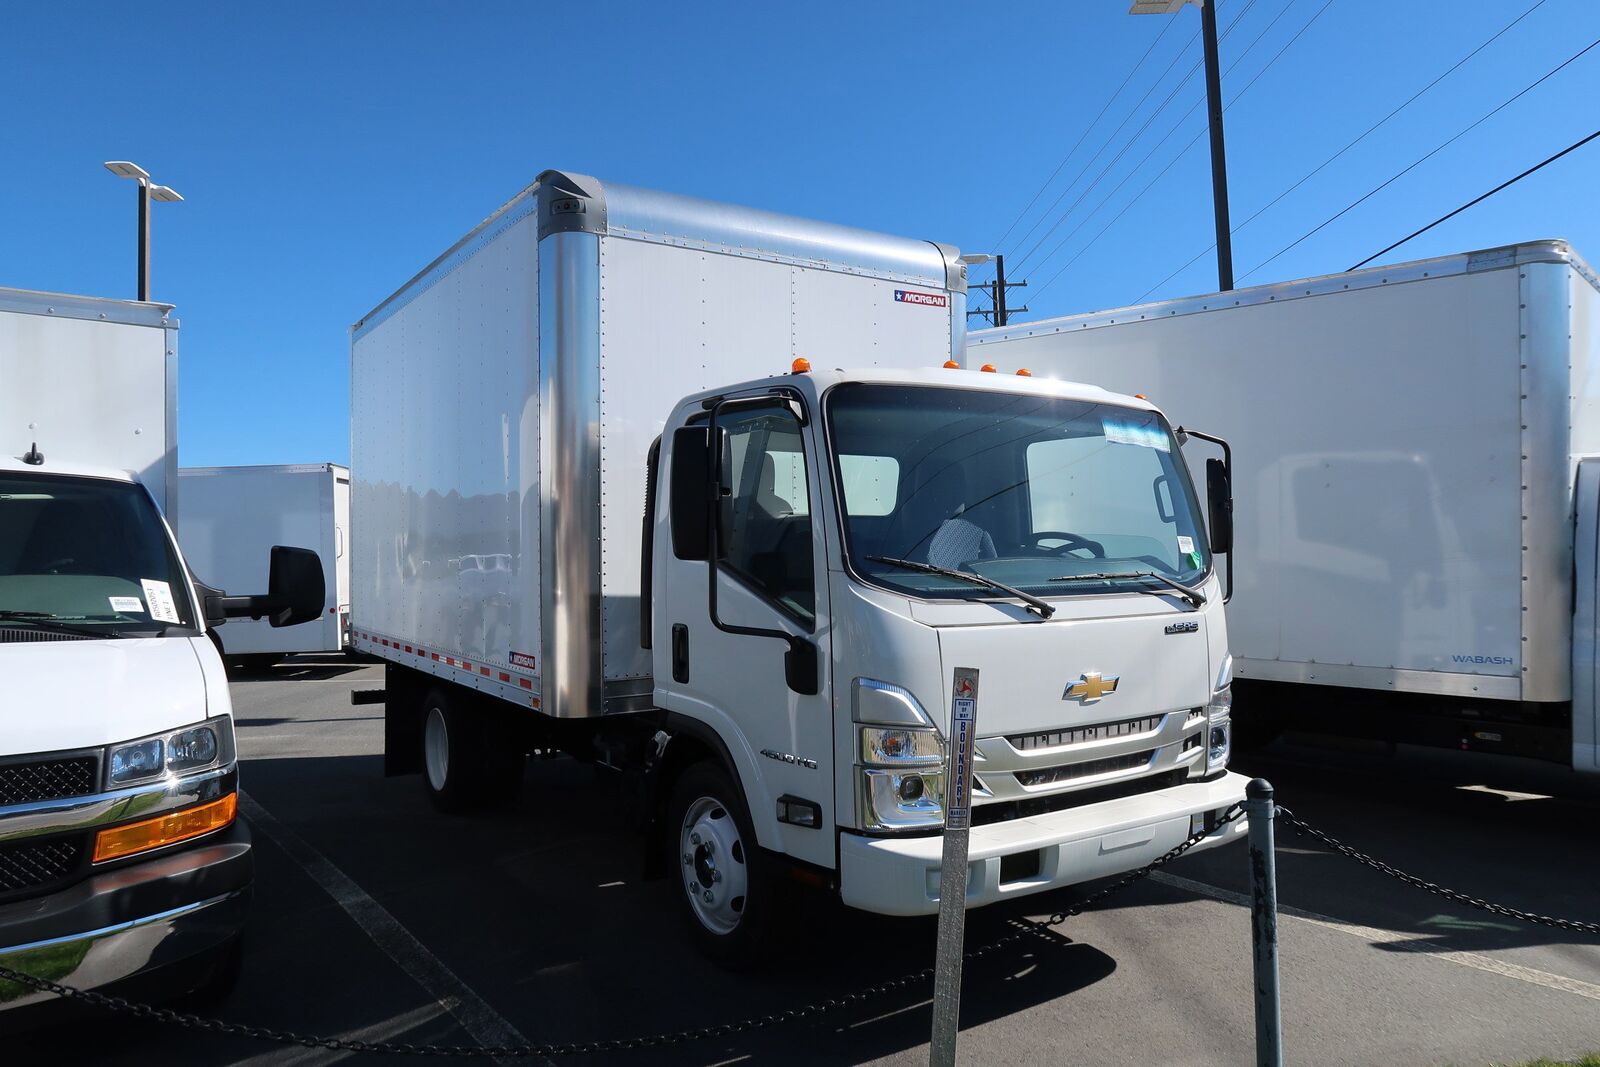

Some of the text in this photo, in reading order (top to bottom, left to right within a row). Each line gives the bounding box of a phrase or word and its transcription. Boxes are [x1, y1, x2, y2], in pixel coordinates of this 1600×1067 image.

[904, 293, 945, 306] MORGAN
[513, 654, 536, 668] MORGAN
[1451, 655, 1513, 665] WABASH
[760, 749, 817, 770] 4500 HG
[956, 721, 967, 807] BOUNDARY
